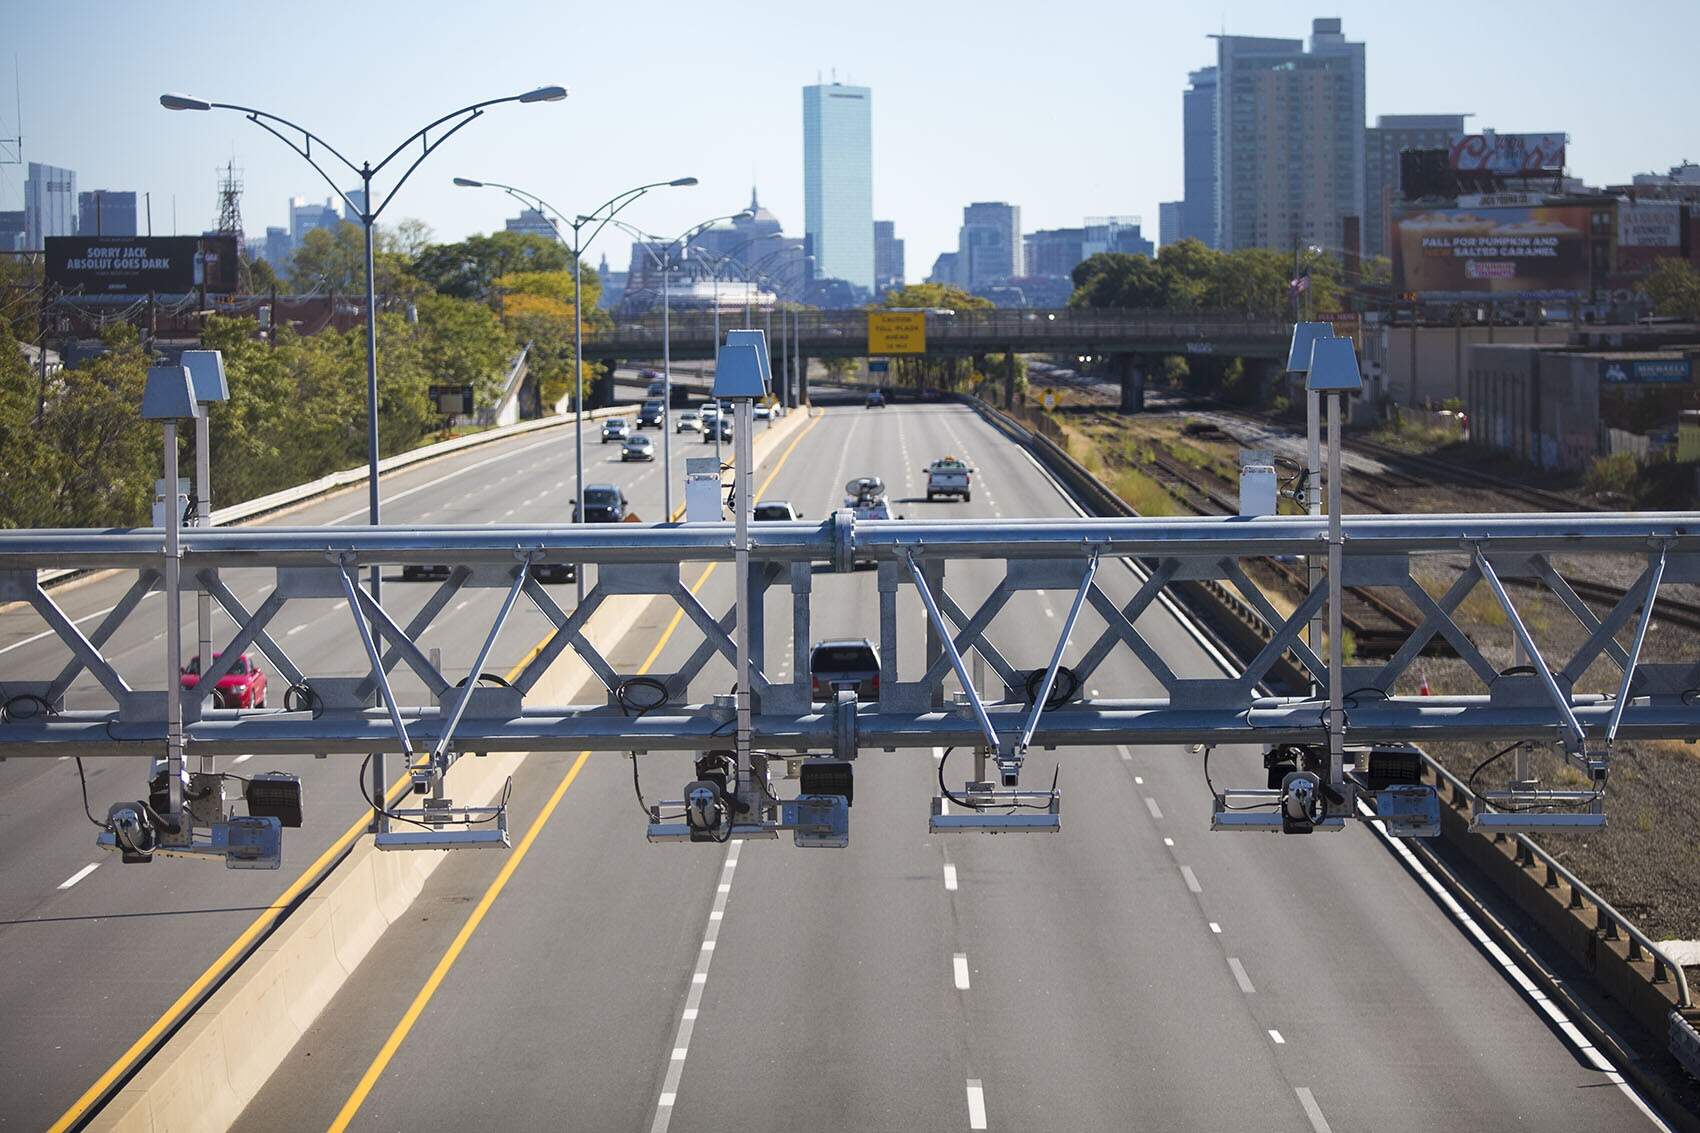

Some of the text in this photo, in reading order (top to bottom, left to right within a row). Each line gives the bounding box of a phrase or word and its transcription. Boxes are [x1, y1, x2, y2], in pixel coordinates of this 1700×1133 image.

[1423, 237, 1558, 247] FALL FOR PUMPKIN AND
[87, 247, 147, 258] SORRY JACK
[1454, 247, 1497, 256] SALTED
[1500, 247, 1557, 256] CARAMEL
[67, 258, 170, 269] ABSOLUT GOES DARK
